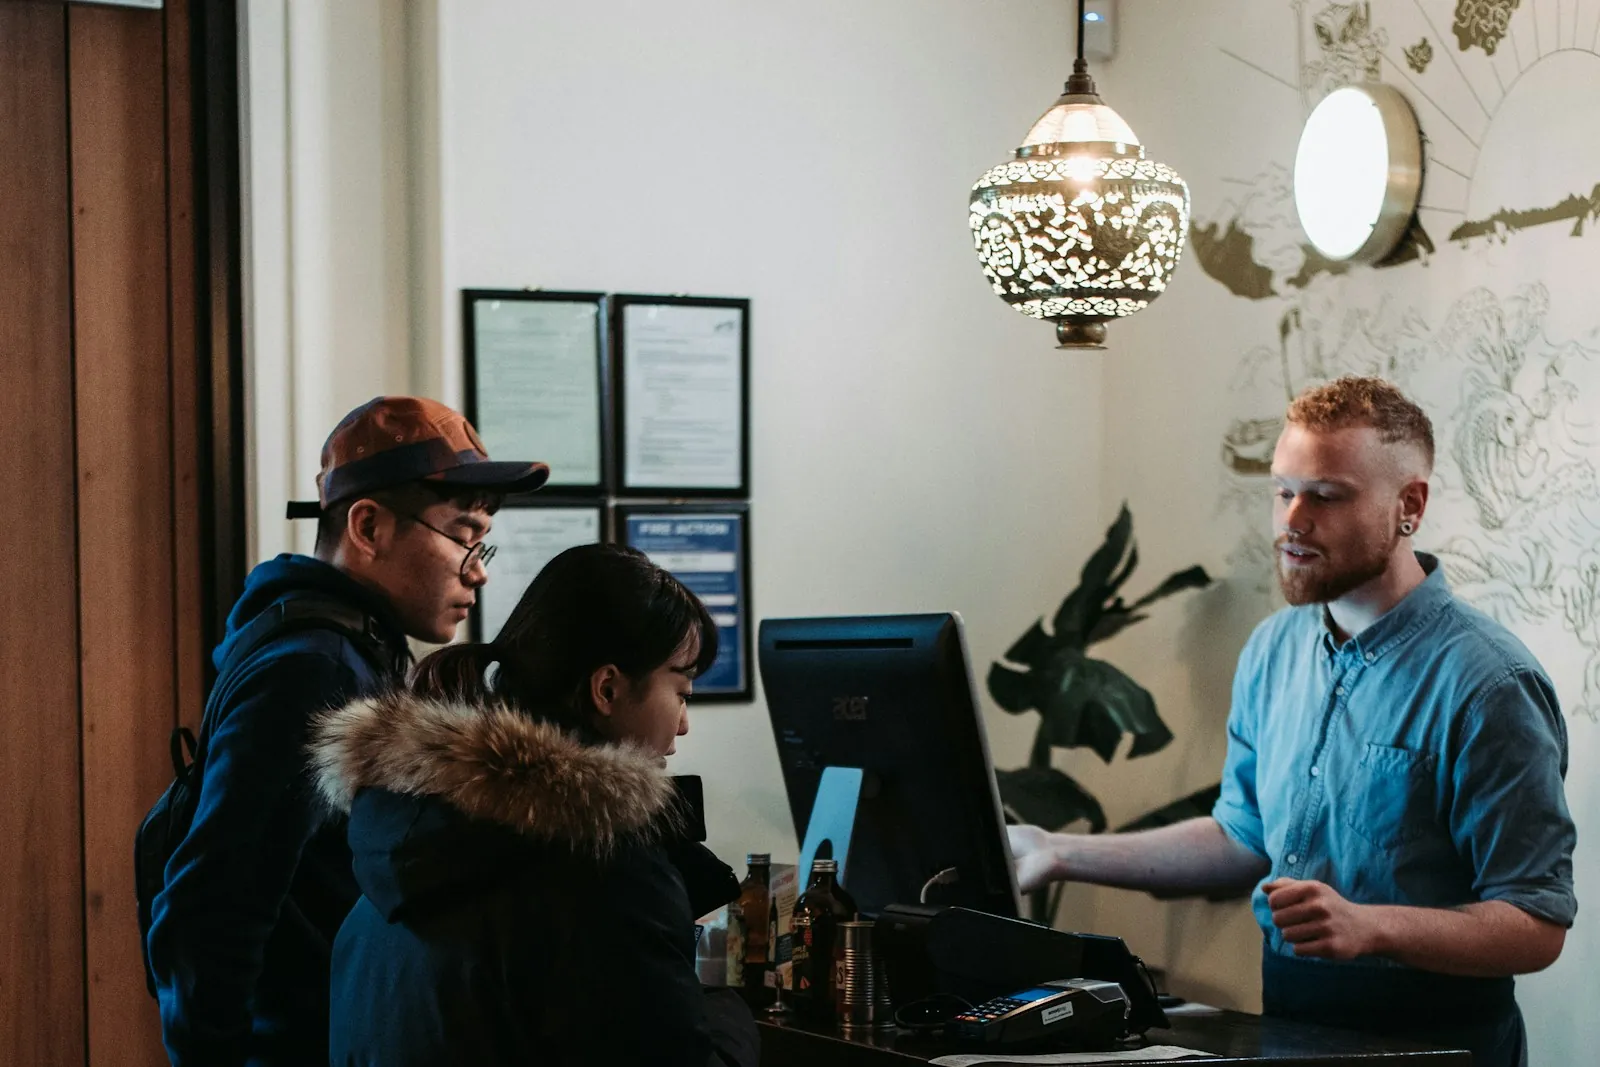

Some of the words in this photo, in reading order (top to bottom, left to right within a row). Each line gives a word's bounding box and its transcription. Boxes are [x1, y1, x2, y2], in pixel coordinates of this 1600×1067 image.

[639, 523, 671, 536] FIRE
[675, 523, 729, 536] ACTION
[832, 697, 869, 721] acer
